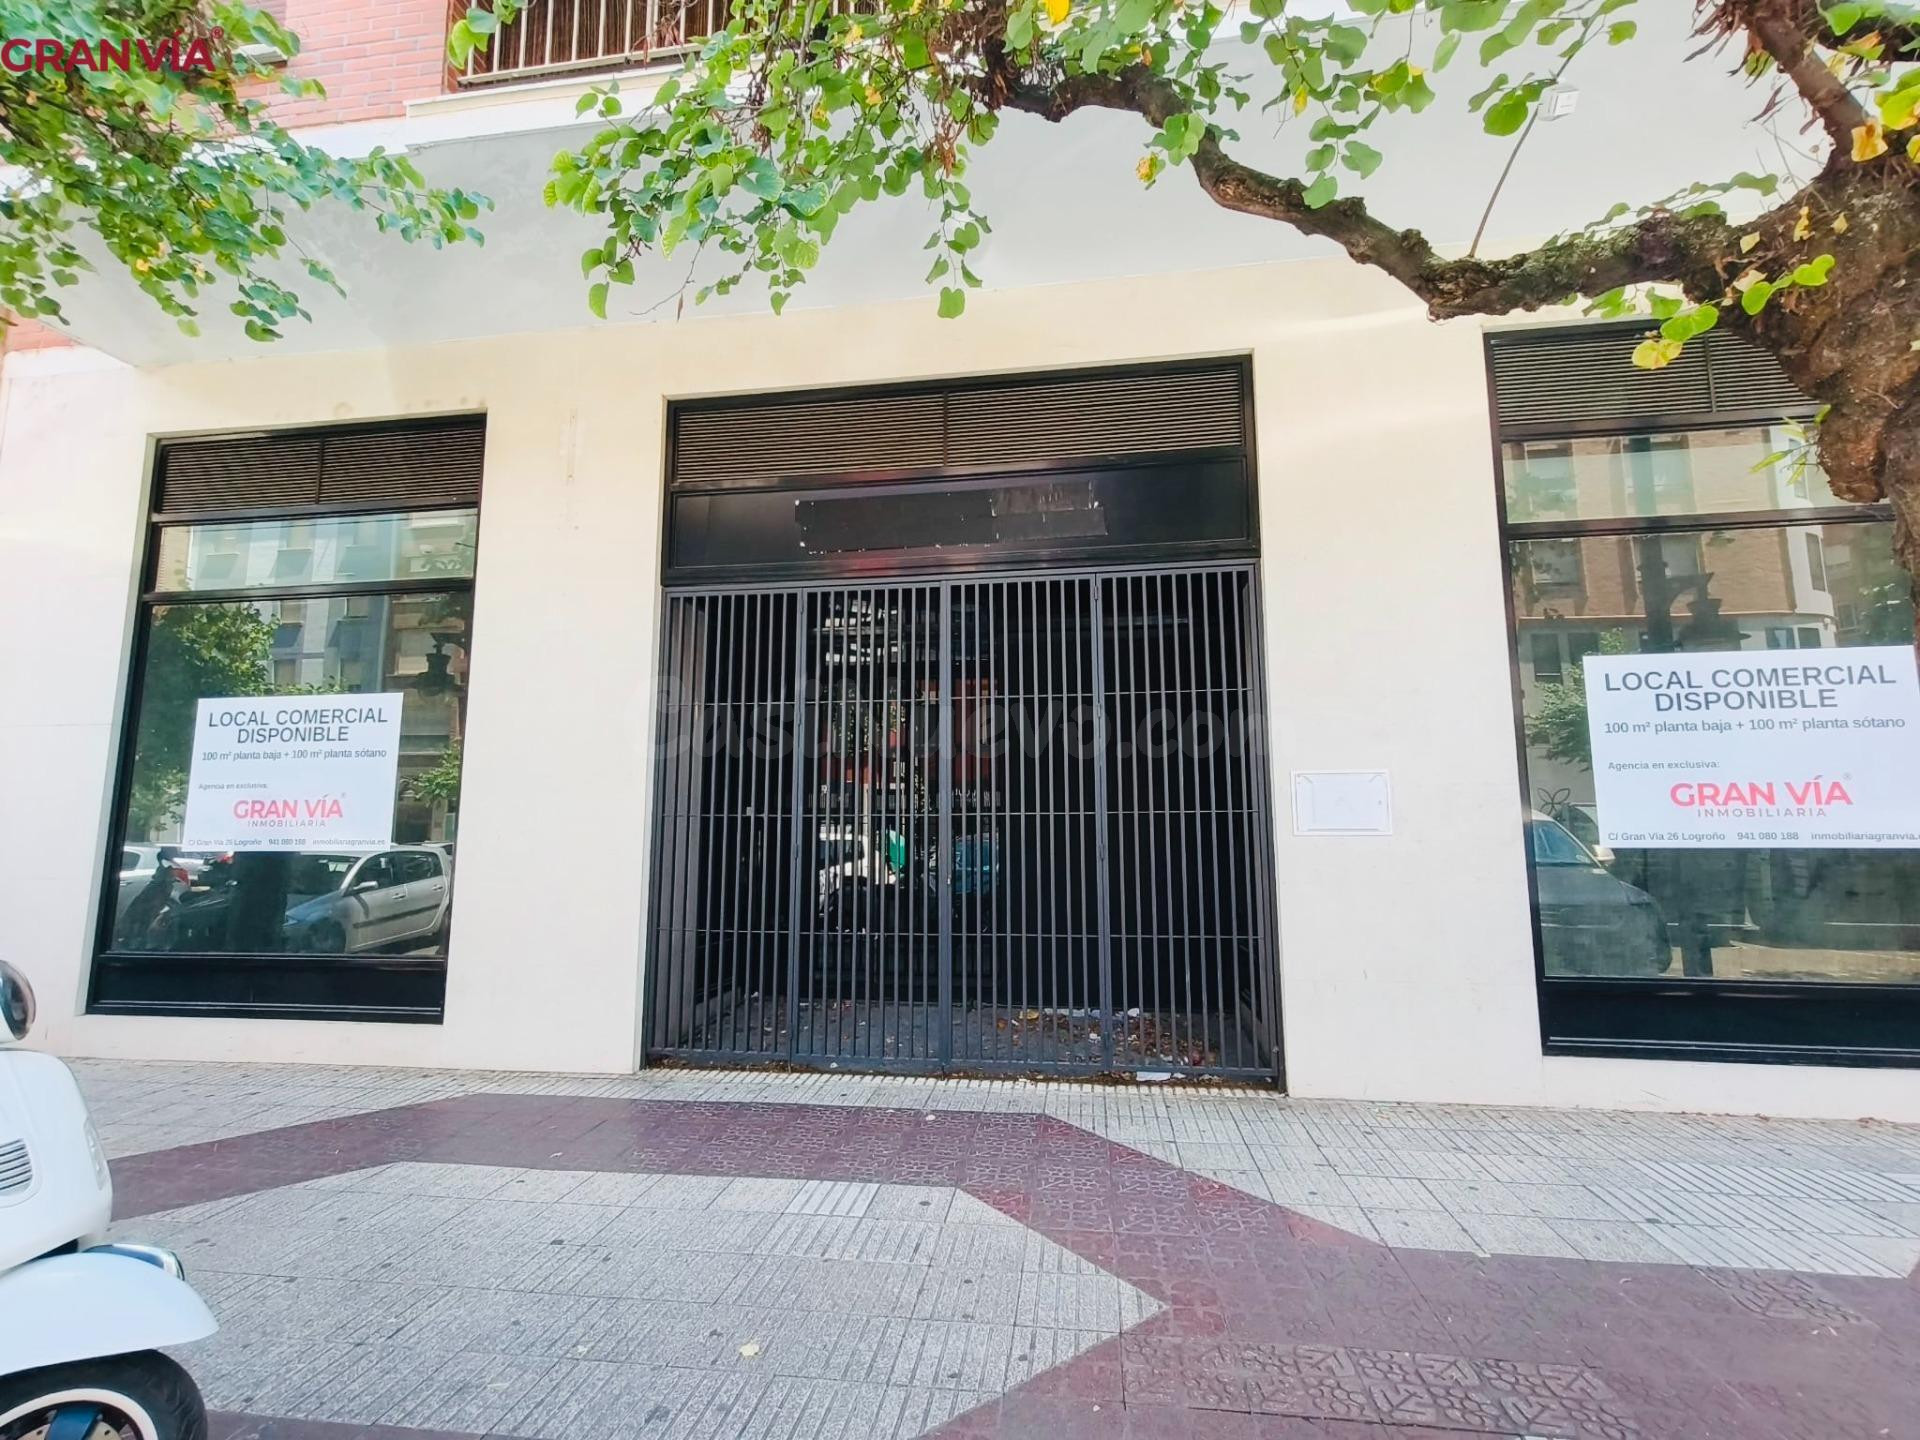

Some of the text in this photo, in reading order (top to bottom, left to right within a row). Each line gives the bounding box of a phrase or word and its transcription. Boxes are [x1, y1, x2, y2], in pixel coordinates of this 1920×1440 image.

[1604, 664, 1897, 691] LOCAL COMERCIAL
[1655, 688, 1838, 712] DISPONIBLE
[208, 707, 388, 728] LOCAL COMERCIAL
[1605, 722, 1629, 734] 100
[1654, 720, 1698, 735] planta
[1701, 719, 1732, 734] baja
[1749, 718, 1775, 731] 100
[1802, 717, 1850, 732] planta
[1852, 716, 1906, 729] sótano
[237, 726, 350, 744] DISPONIBLE
[202, 751, 219, 761] 100
[232, 750, 261, 762] planta
[262, 750, 282, 761] baja
[292, 749, 309, 759] 100
[323, 748, 353, 760] planta
[354, 747, 387, 758] sótano
[1608, 760, 1721, 772] Agencia en exclusiva:
[198, 783, 225, 791] Agencia
[1670, 774, 1854, 807] GRAN VÍA
[233, 794, 344, 819] GRAN VÍA
[1697, 808, 1827, 818] INMOBILIARIA
[247, 819, 327, 828] INMOBILIARIA
[1621, 832, 1646, 841] Gran
[1667, 832, 1679, 841] 26
[1681, 832, 1726, 843] Logroño
[1736, 832, 1756, 841] 941
[1758, 832, 1778, 841] 080
[1780, 832, 1800, 841] 188
